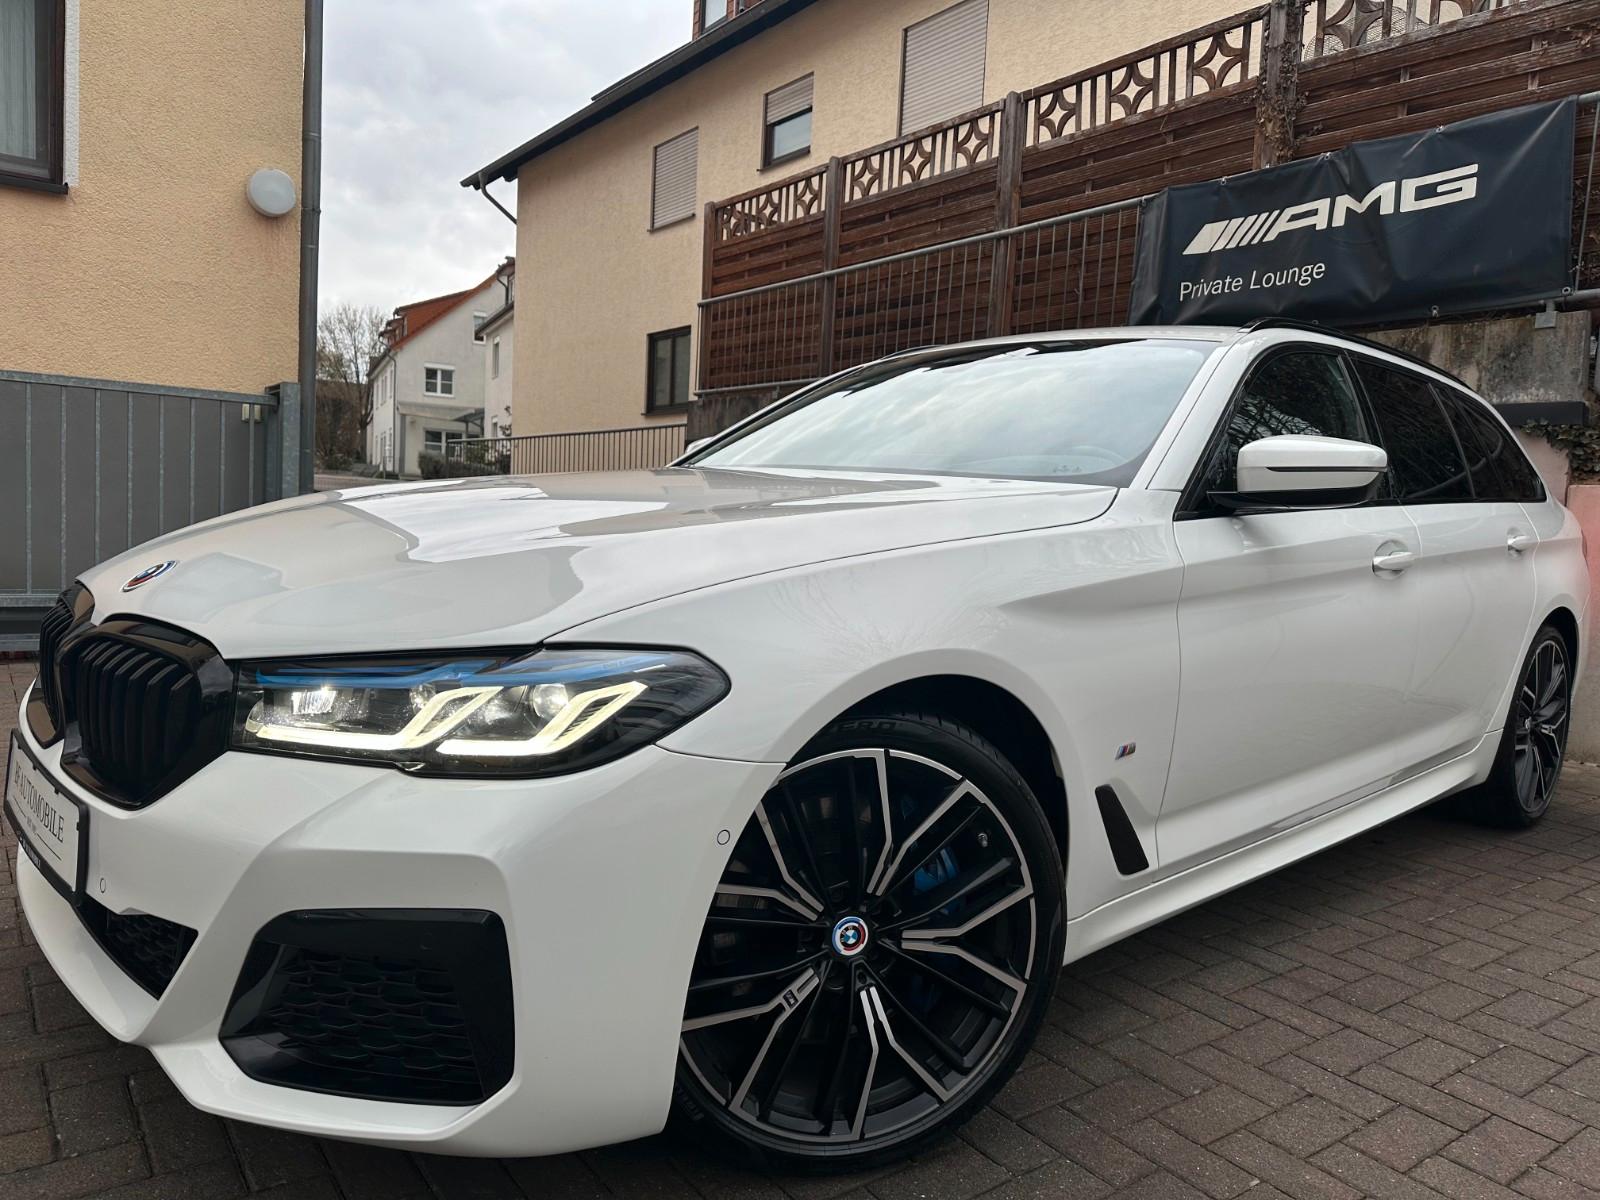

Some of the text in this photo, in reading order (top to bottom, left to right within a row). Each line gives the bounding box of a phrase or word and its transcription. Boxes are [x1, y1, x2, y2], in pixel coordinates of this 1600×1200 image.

[1264, 163, 1479, 242] AMG
[1179, 261, 1326, 302] Private Lounge
[20, 771, 65, 843] AUTOMOBILE
